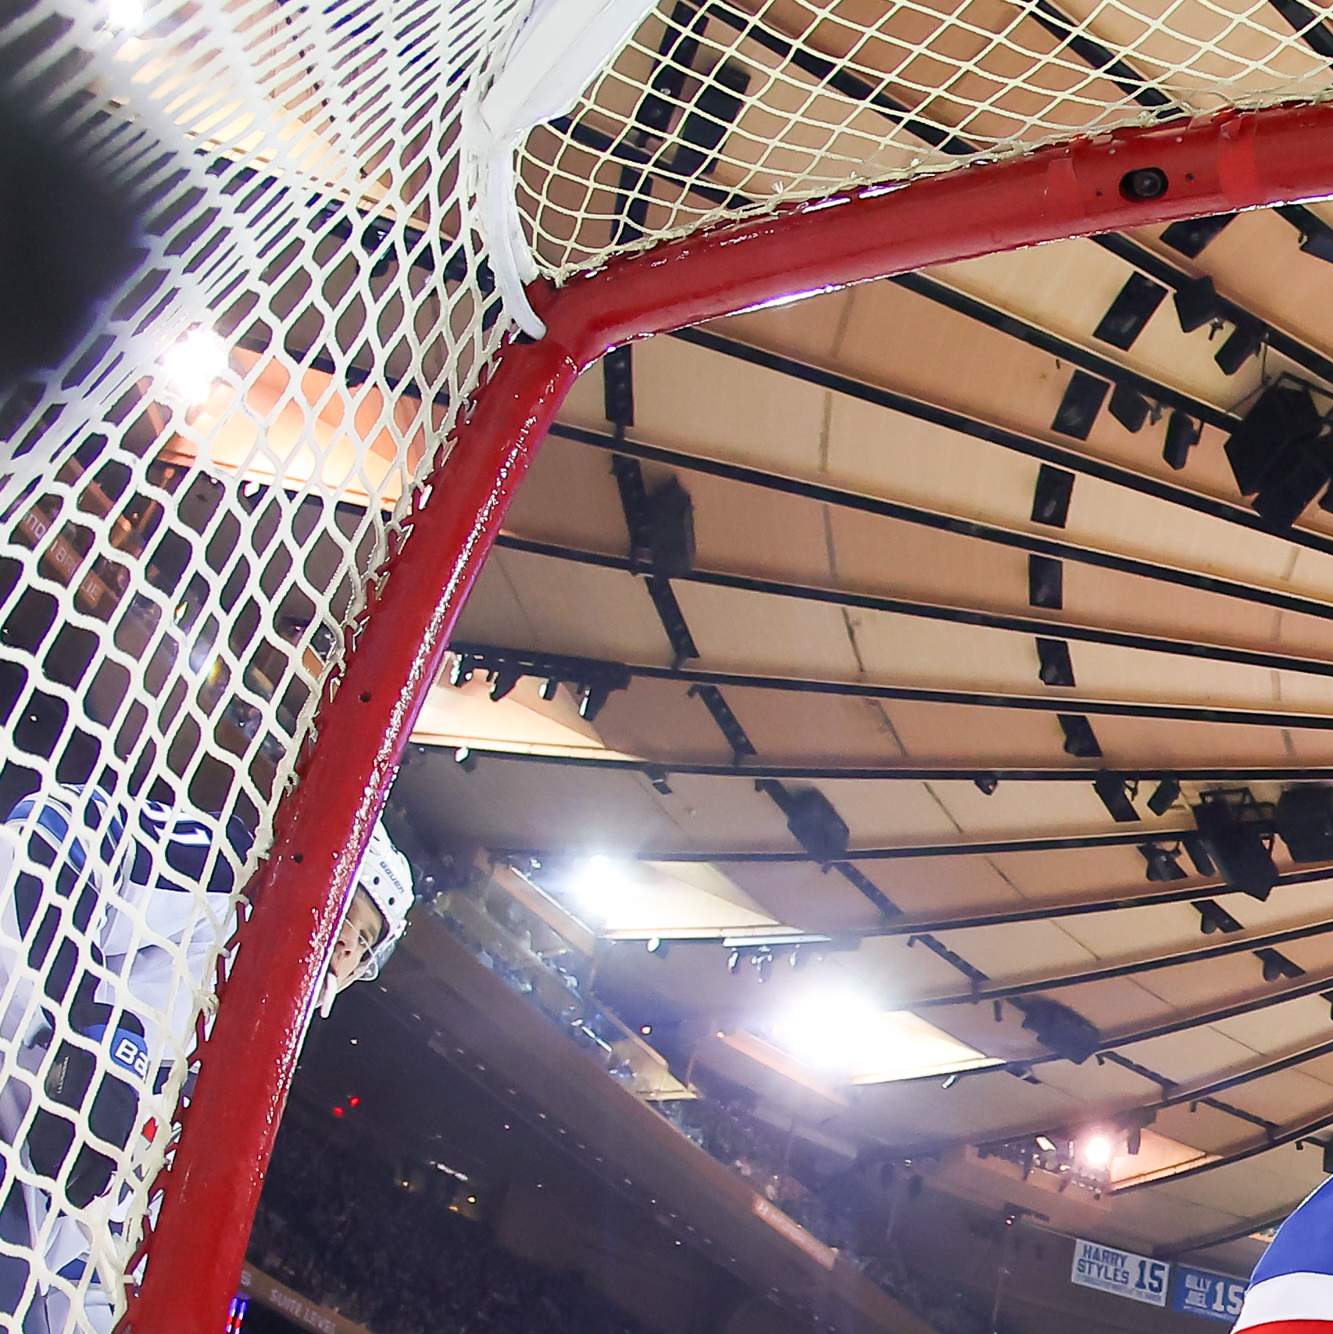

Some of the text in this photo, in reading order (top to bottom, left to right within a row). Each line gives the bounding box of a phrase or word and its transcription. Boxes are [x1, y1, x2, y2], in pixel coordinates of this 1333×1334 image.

[1082, 1244, 1128, 1269] HARRY
[1077, 1259, 1130, 1286] STYLES
[1134, 1260, 1166, 1295] 15
